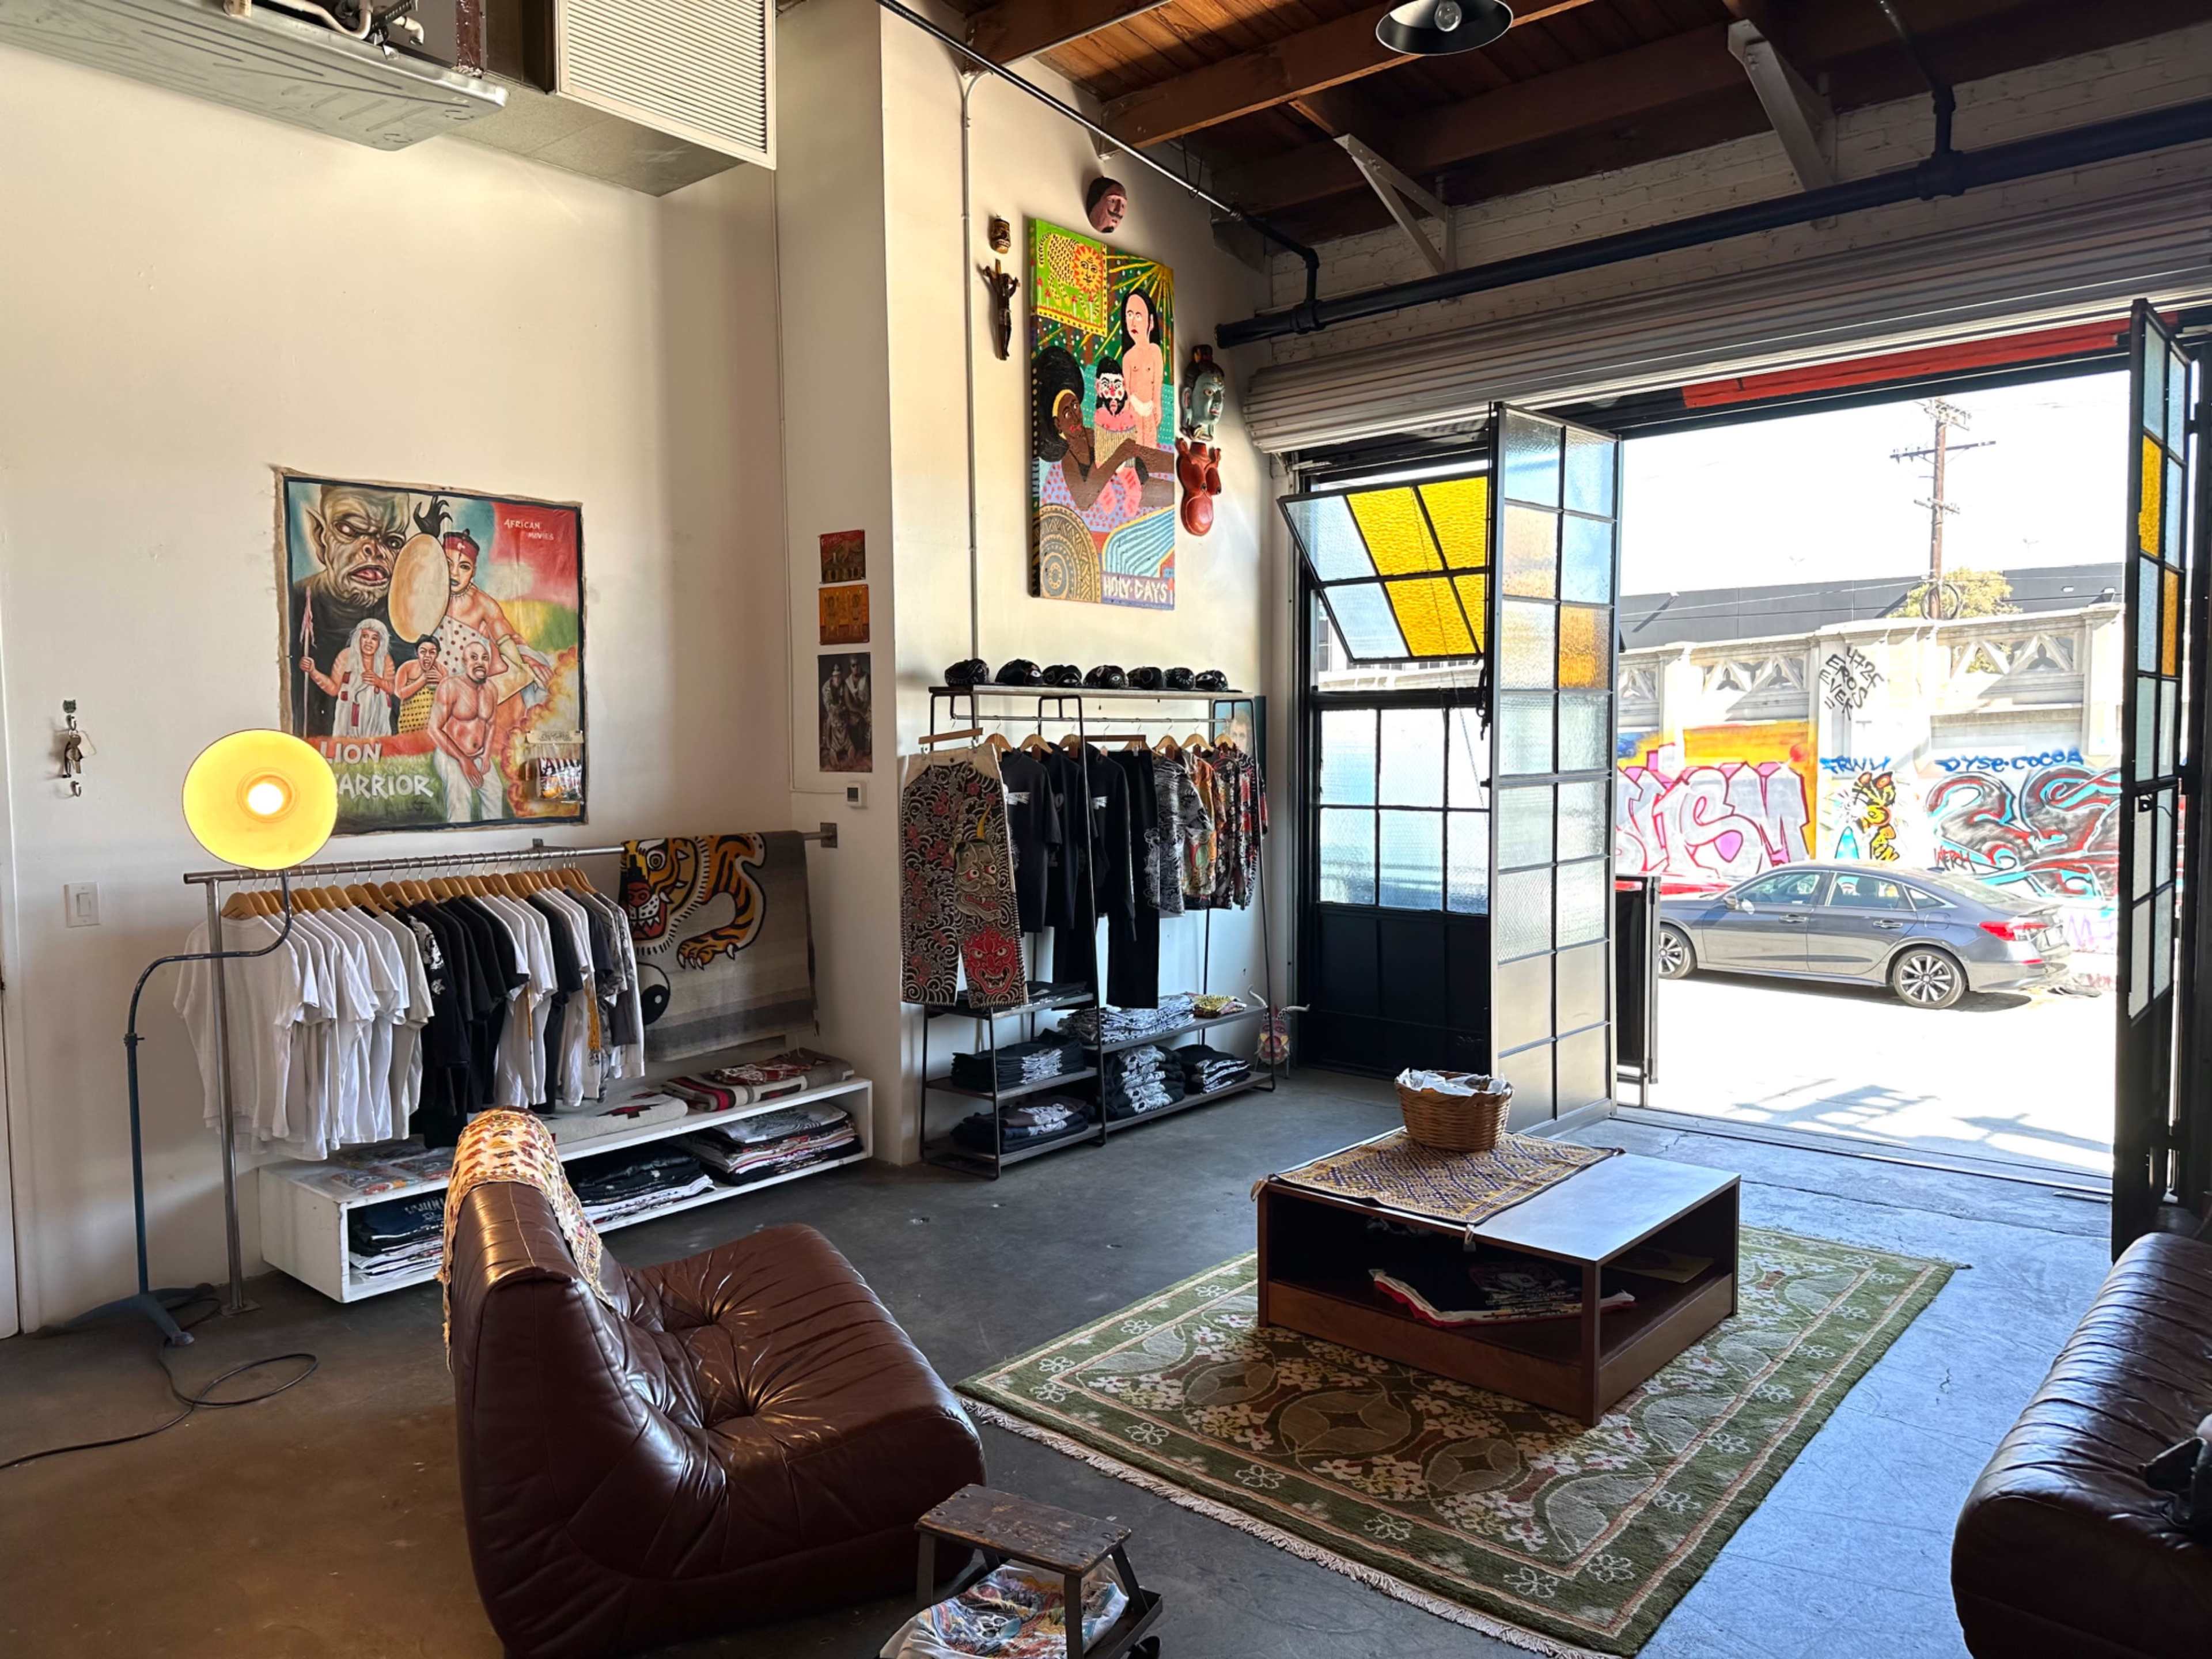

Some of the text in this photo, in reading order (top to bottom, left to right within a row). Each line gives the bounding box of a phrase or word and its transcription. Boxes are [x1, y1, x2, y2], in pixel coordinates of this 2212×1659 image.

[503, 518, 540, 529] AFRICAN
[320, 741, 382, 764] LION
[336, 772, 434, 800] ARRIOR
